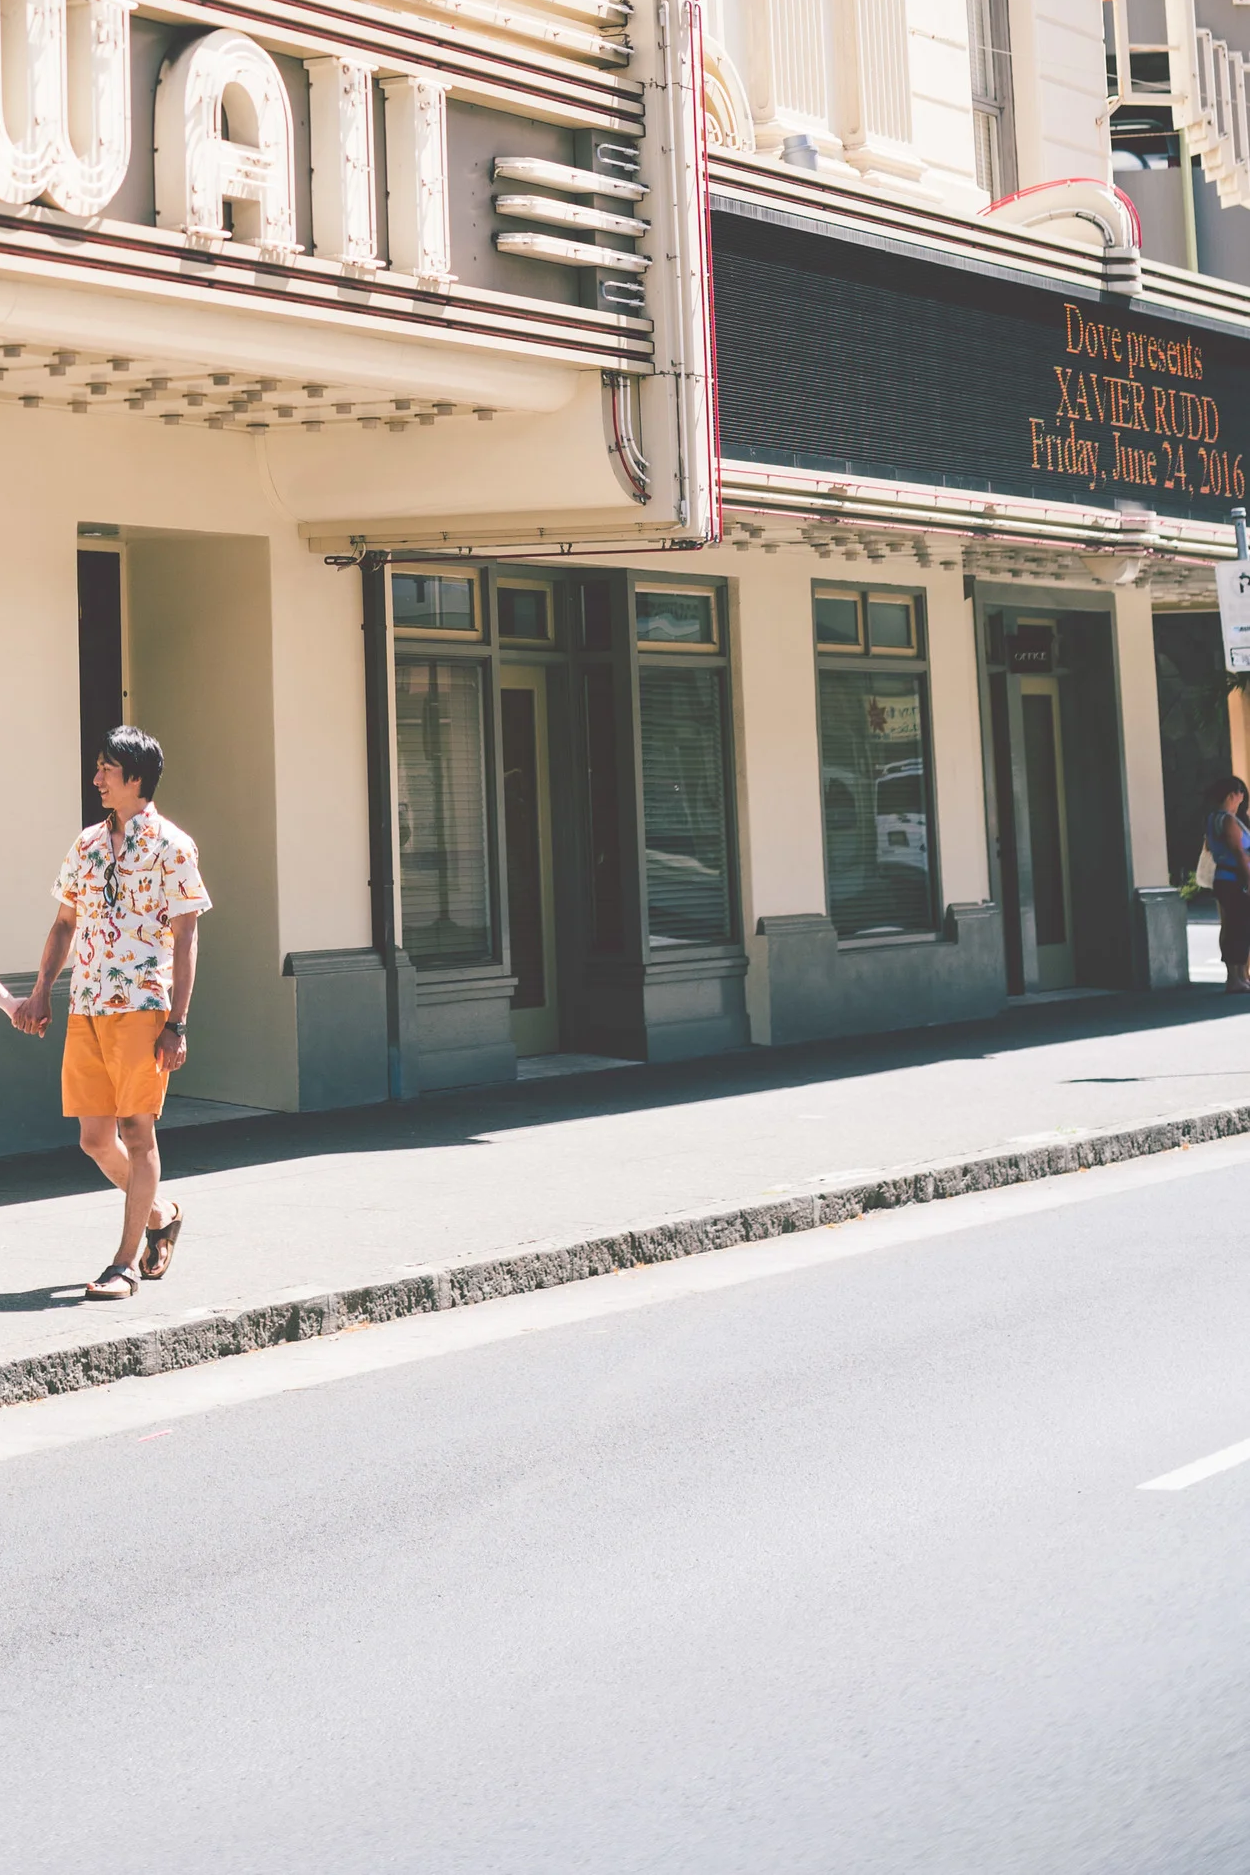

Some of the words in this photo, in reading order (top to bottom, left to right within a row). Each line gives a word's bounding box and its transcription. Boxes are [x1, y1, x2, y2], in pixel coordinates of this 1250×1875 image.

[1064, 302, 1122, 362] Dove
[1127, 330, 1203, 380] presents
[1053, 366, 1150, 432] XAVIER
[1152, 386, 1219, 443] RUDD
[1029, 417, 1106, 490] Friday,
[1112, 432, 1157, 486] June
[1161, 441, 1194, 500] 24,
[1198, 446, 1245, 499] 2016
